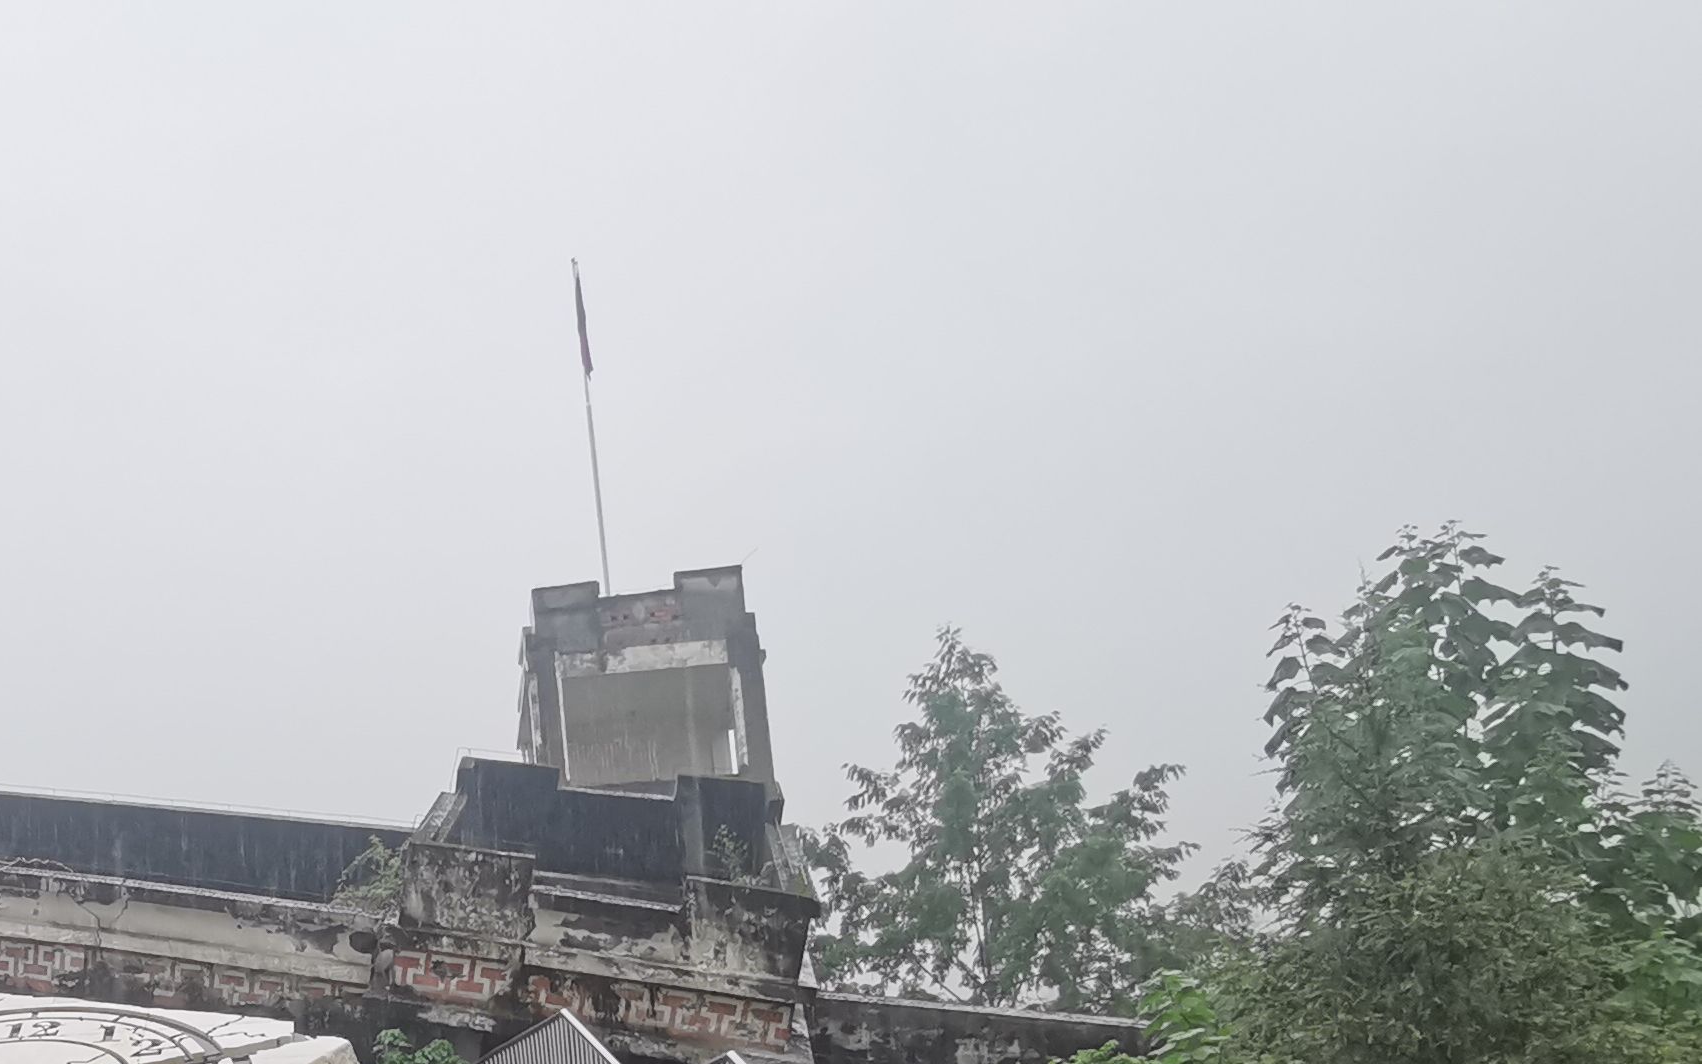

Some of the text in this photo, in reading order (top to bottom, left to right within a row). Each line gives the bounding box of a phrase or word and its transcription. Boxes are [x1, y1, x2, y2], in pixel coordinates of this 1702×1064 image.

[5, 1020, 62, 1039] 12
[95, 1024, 122, 1043] 1
[131, 1038, 163, 1057] 2
